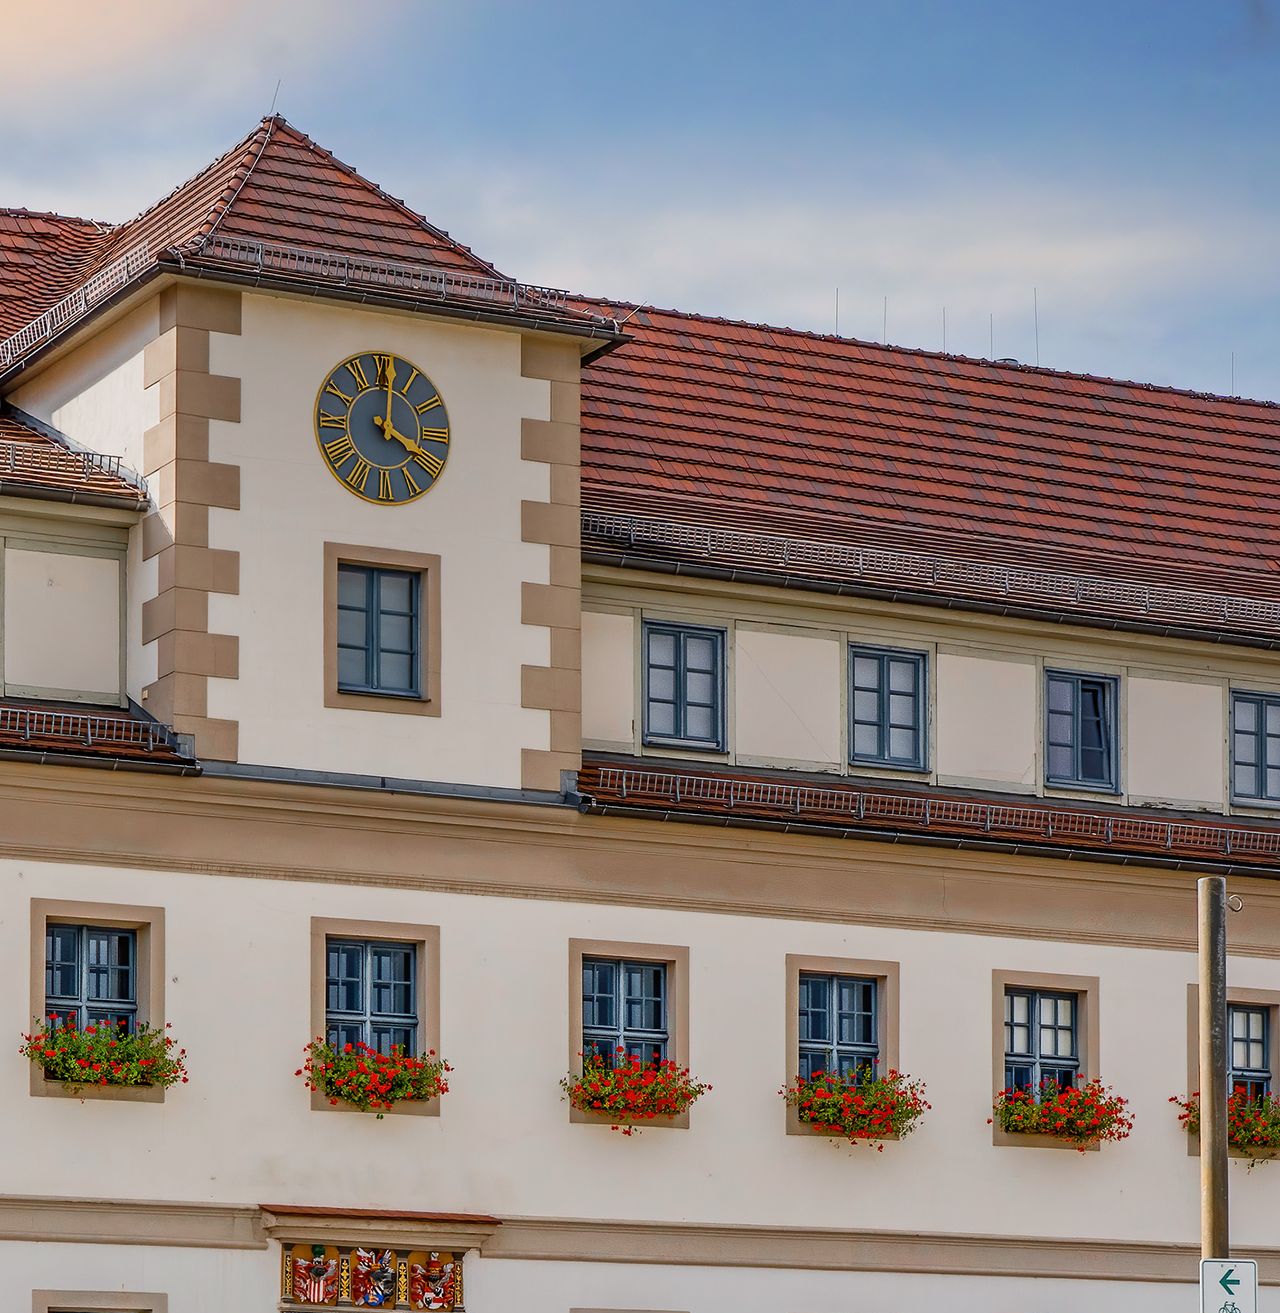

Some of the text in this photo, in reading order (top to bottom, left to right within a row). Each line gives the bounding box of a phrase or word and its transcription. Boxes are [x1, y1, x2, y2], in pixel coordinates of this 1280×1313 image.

[345, 359, 370, 392] XI
[373, 355, 393, 385] XI
[401, 368, 420, 395] I
[325, 380, 354, 407] X
[415, 394, 442, 415] II
[320, 409, 347, 430] IX
[422, 426, 449, 445] III
[324, 435, 355, 470] VIII
[413, 446, 445, 479] IIII
[346, 458, 372, 493] VII
[378, 469, 395, 500] VI
[401, 466, 422, 497] V
